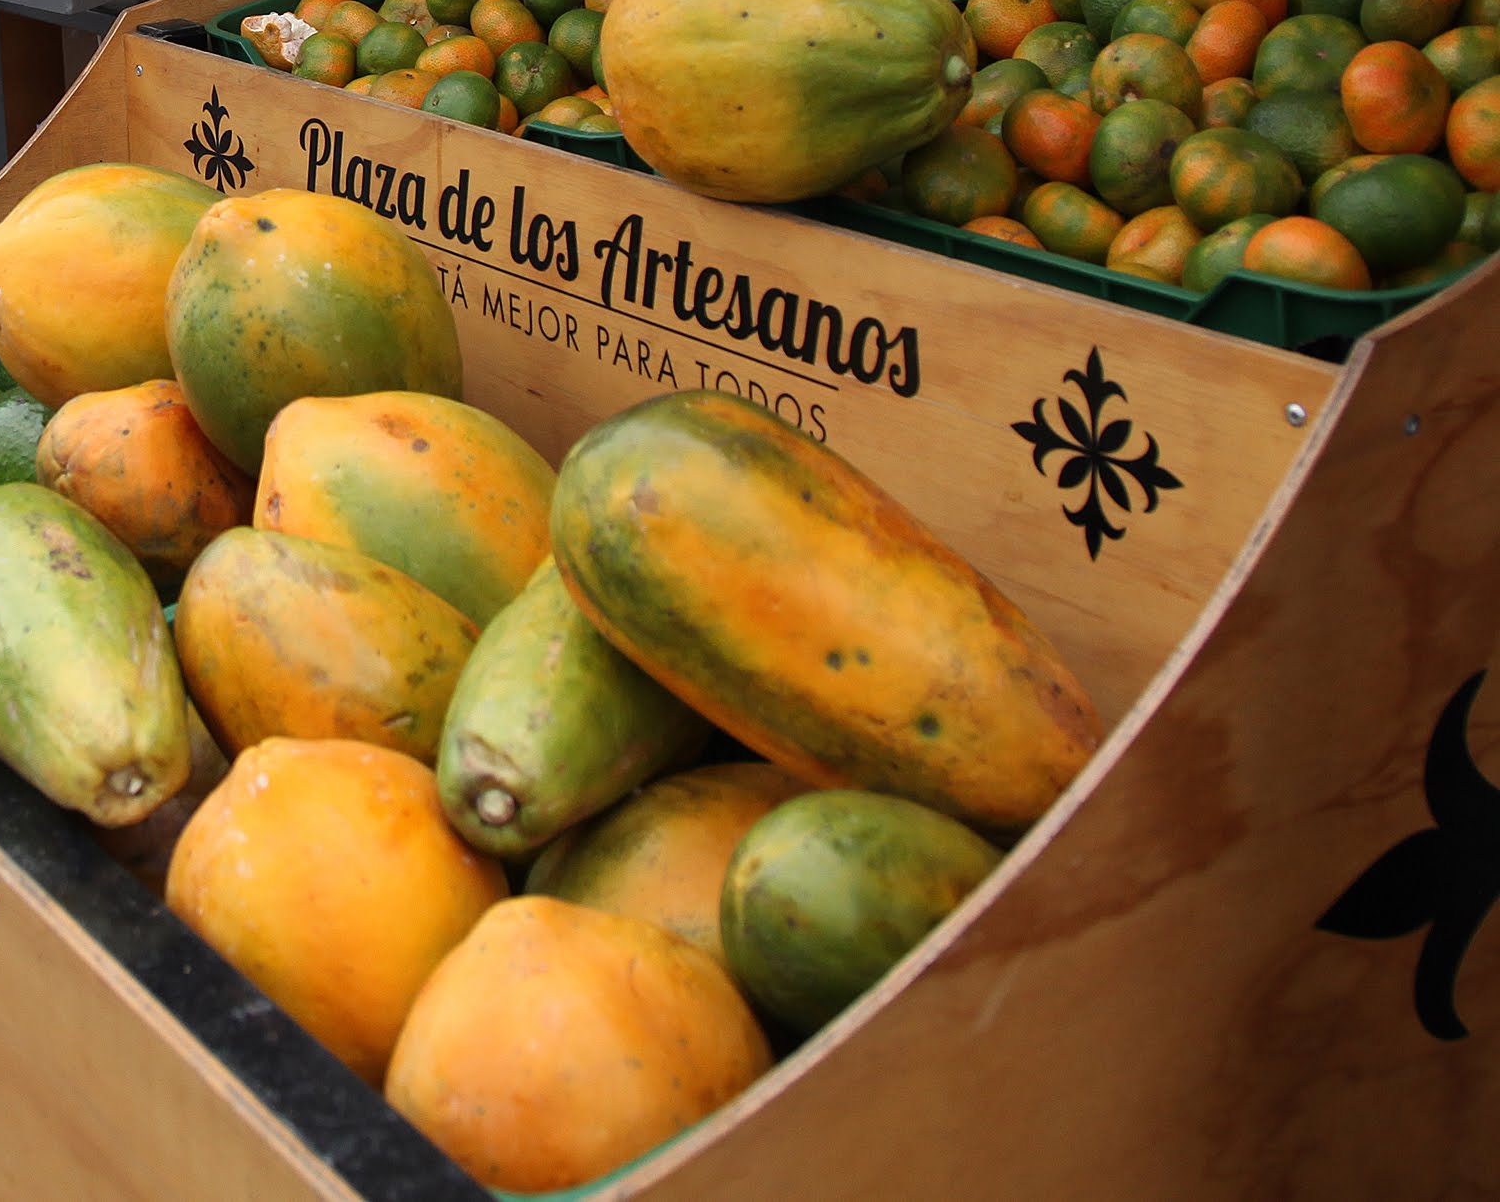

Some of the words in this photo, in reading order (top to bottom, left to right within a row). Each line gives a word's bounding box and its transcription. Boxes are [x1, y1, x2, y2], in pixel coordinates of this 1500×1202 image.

[299, 118, 428, 231] Plaza
[438, 168, 496, 253] de
[509, 185, 580, 282] los
[593, 214, 921, 398] Artesanos
[482, 282, 580, 352] MEJOR
[596, 324, 679, 390] PARA
